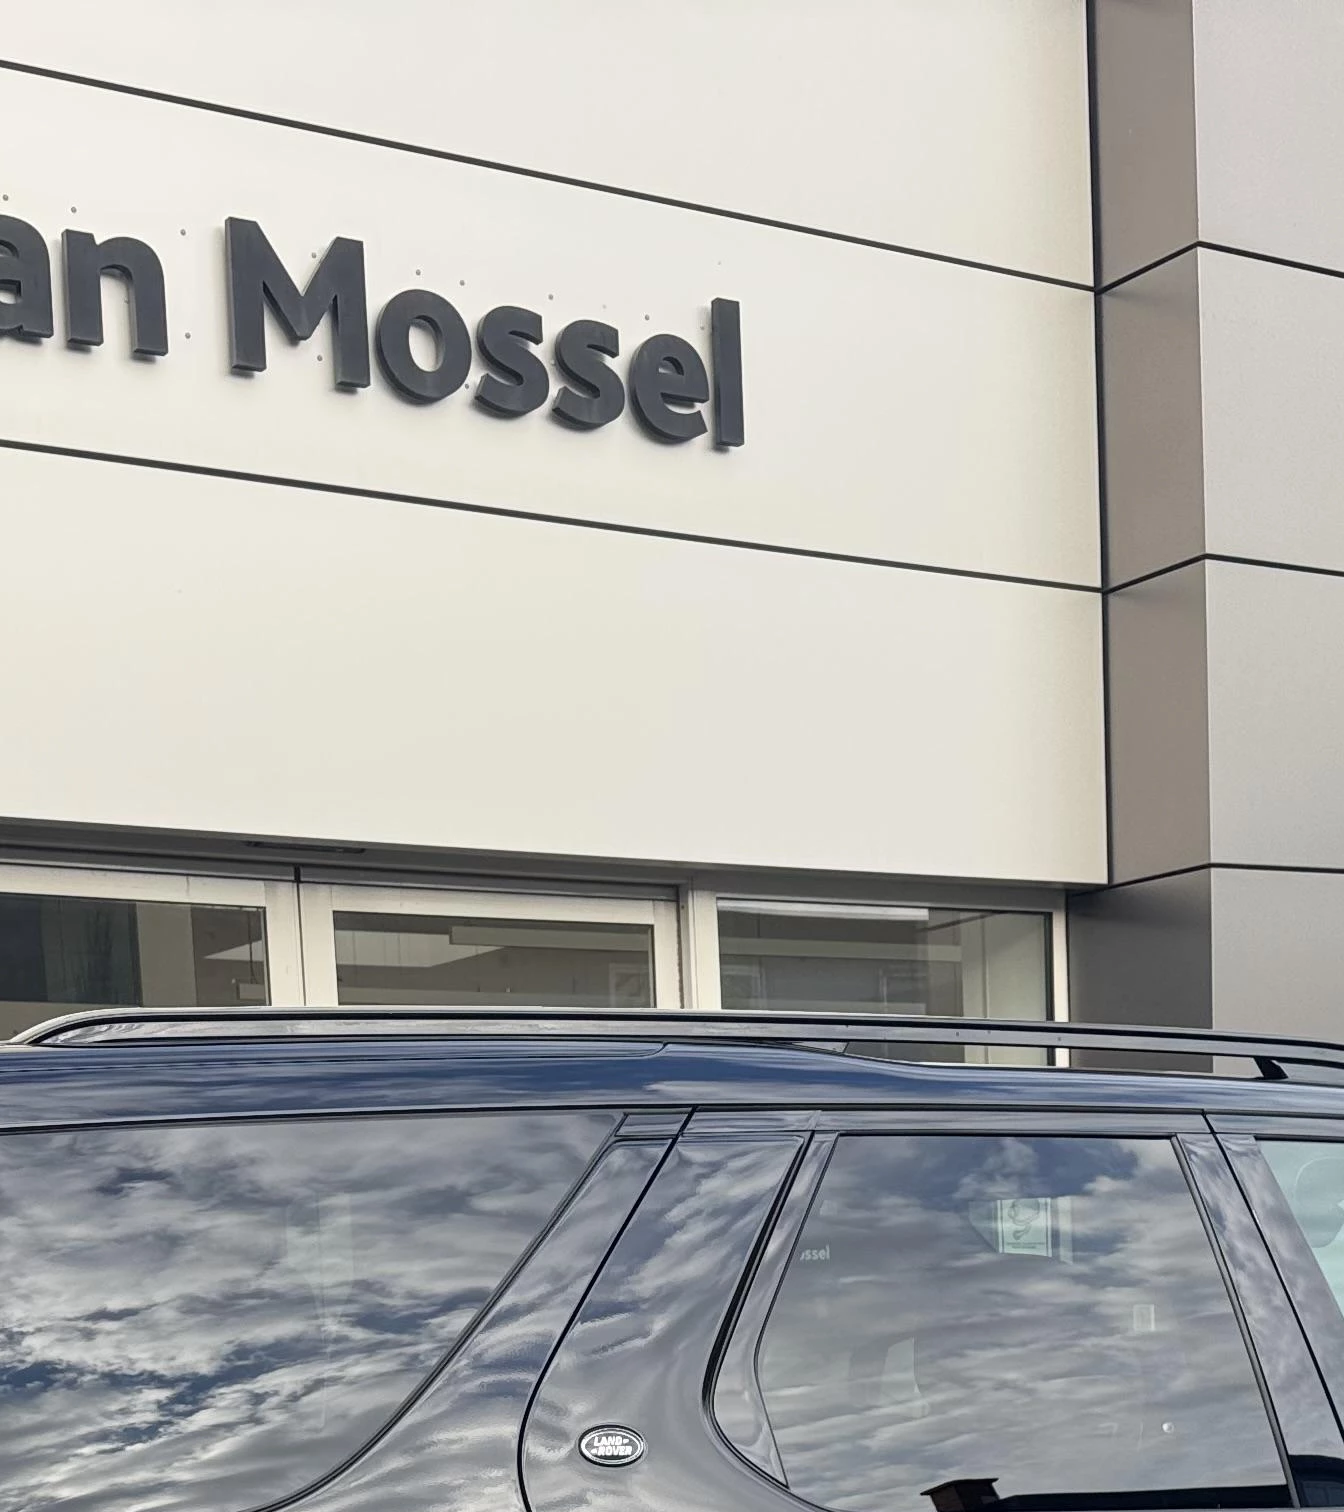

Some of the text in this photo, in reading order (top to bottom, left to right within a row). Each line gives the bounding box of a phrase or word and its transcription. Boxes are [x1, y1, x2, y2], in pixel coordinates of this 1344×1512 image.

[223, 215, 745, 449] Mossel
[799, 1243, 830, 1261] ssel
[594, 1436, 623, 1446] LAND
[598, 1446, 633, 1456] ROVER
